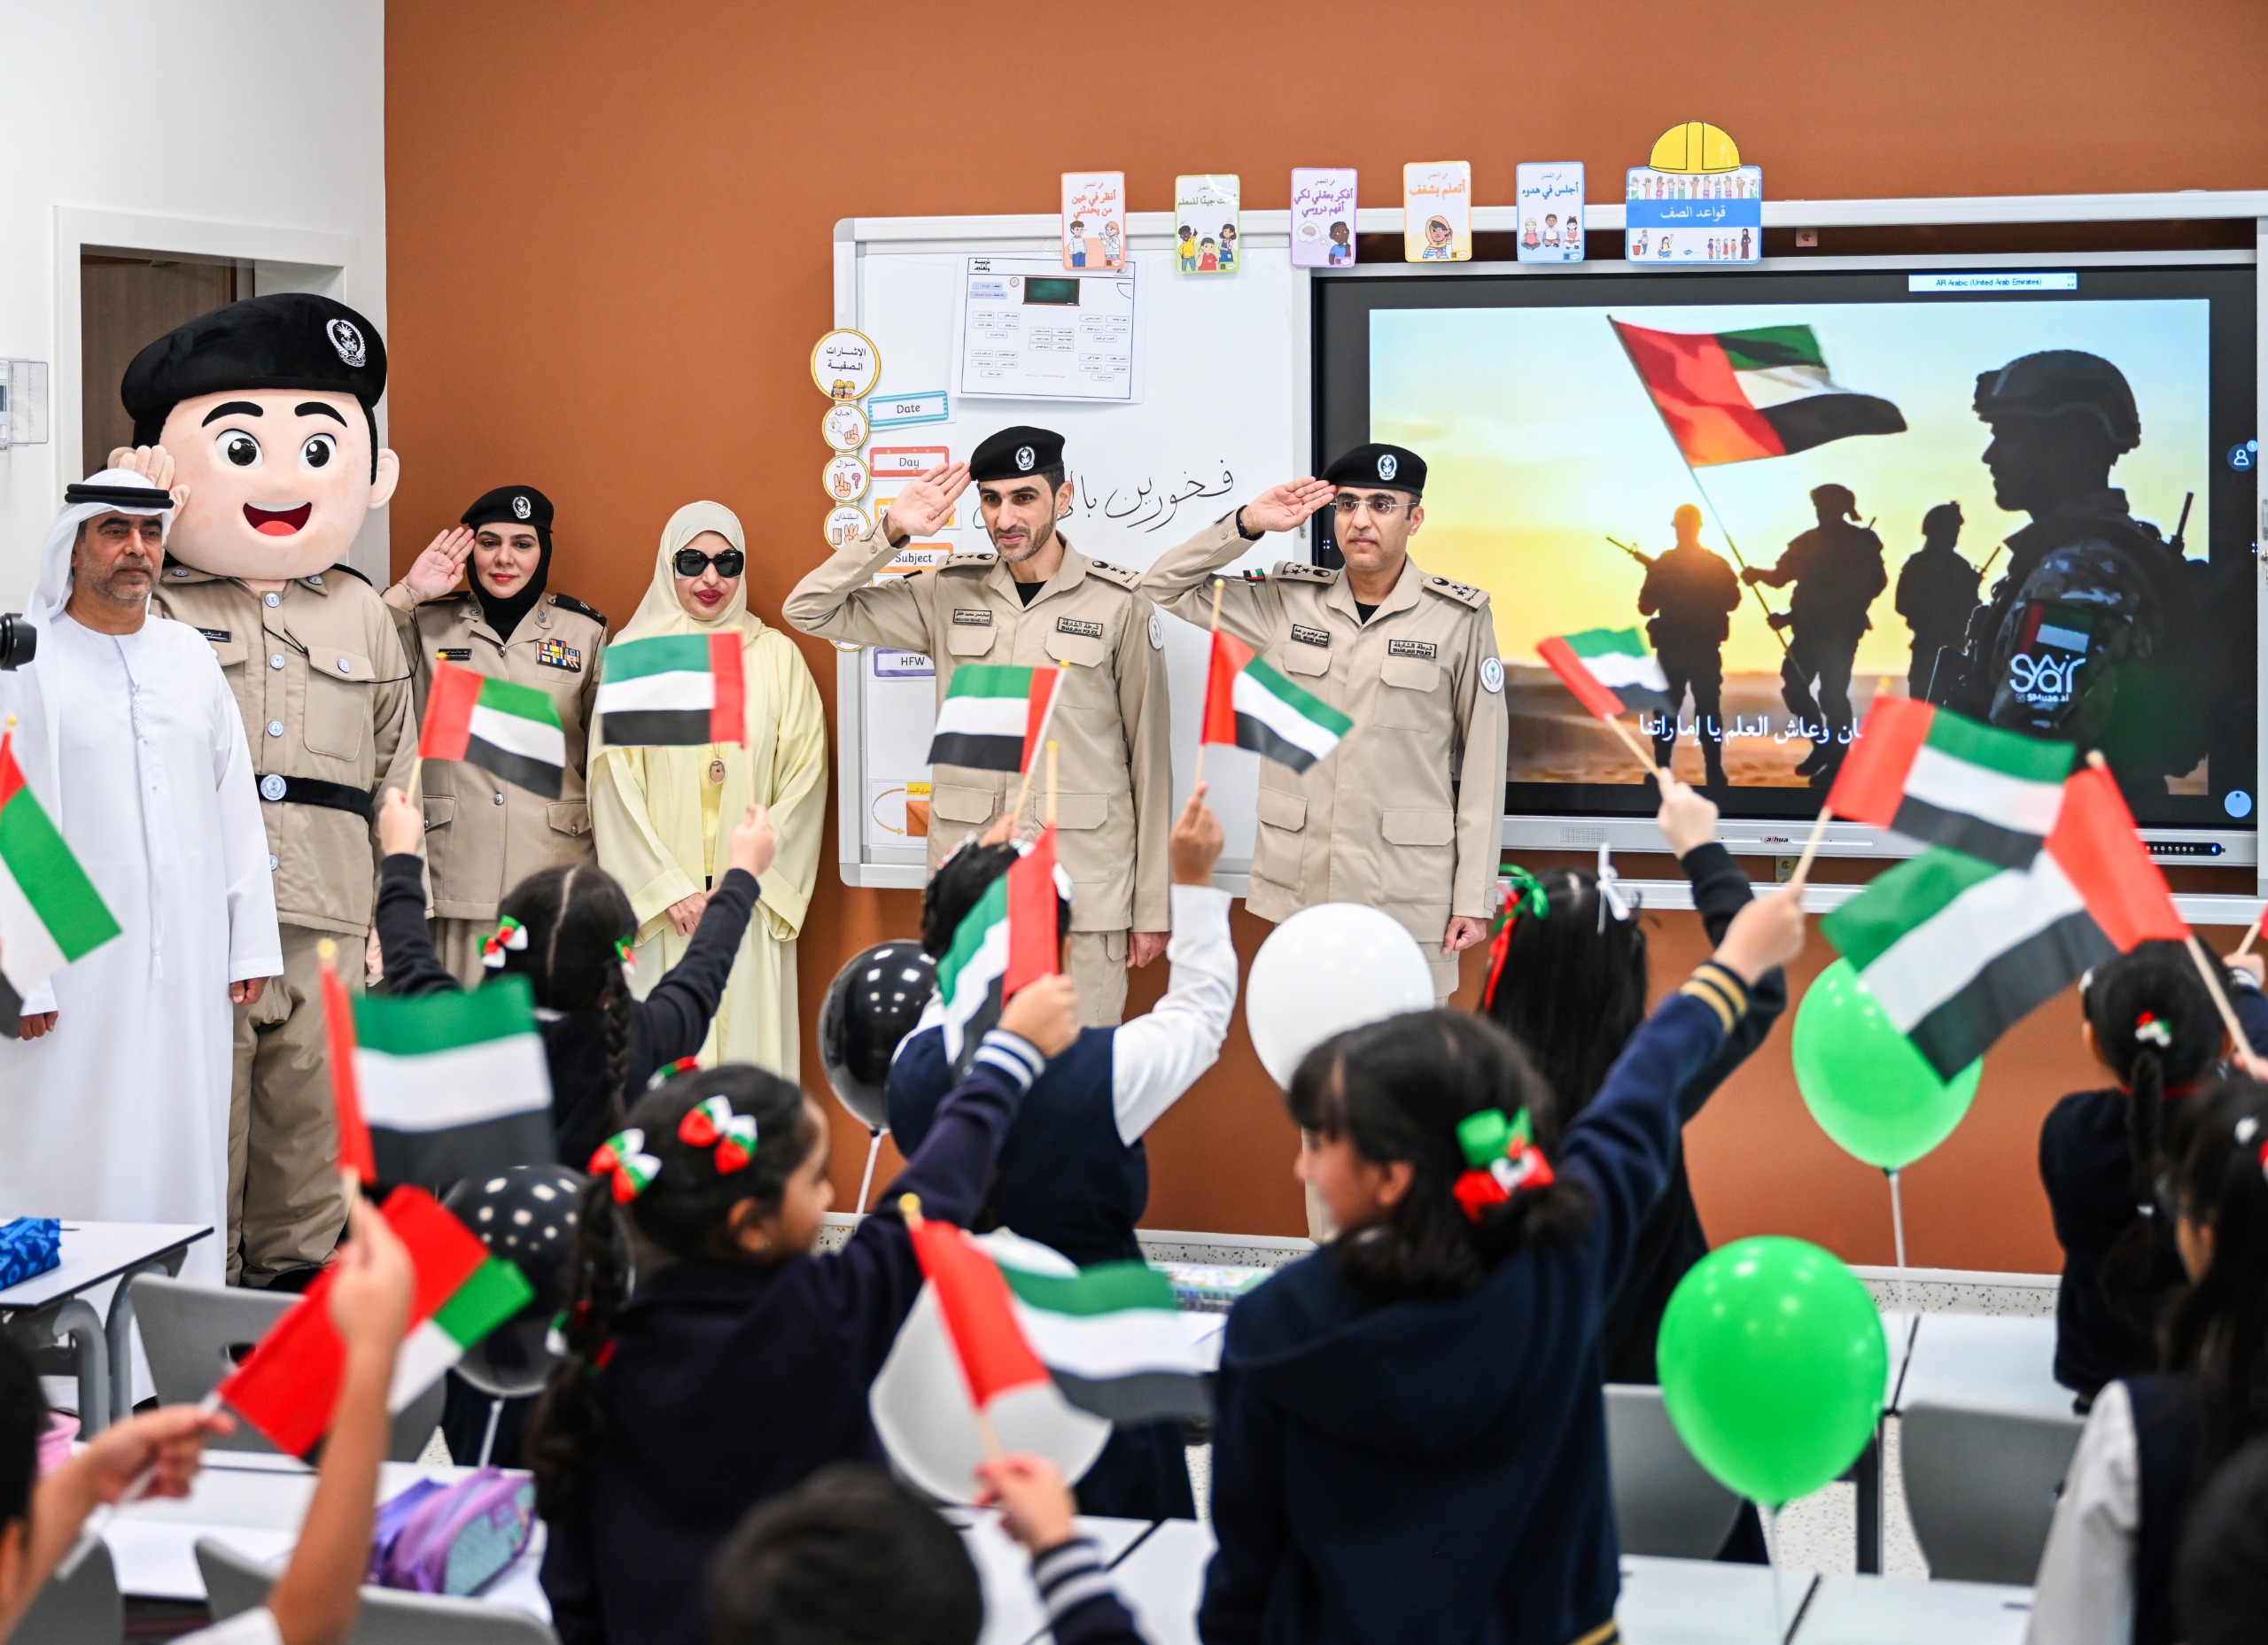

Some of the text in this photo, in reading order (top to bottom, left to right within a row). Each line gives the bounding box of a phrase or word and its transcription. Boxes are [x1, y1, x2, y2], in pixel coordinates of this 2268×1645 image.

[1409, 178, 1466, 200] أتعلم بشغف
[1522, 181, 1579, 199] أجلس في هدوء
[1071, 189, 1116, 207] أنظر في عين
[1177, 197, 1199, 209] للمعلم
[1293, 187, 1354, 206] أفكر بعقلي لكي
[1073, 205, 1113, 220] من يحدثني
[1301, 200, 1345, 219] أفهم دروسي
[1659, 205, 1726, 222] قواعد الصف
[826, 345, 866, 359] الإشارات
[827, 359, 863, 371] الصفية
[897, 404, 920, 414] Date
[835, 459, 857, 469] سؤال
[899, 457, 920, 469] Day
[1105, 459, 1234, 533] فخورين
[895, 553, 933, 566] Subject
[1061, 619, 1083, 628] الشارقة
[901, 656, 925, 665] HFW
[1639, 713, 1863, 746] ان وعاش العلم يا إماراتنا
